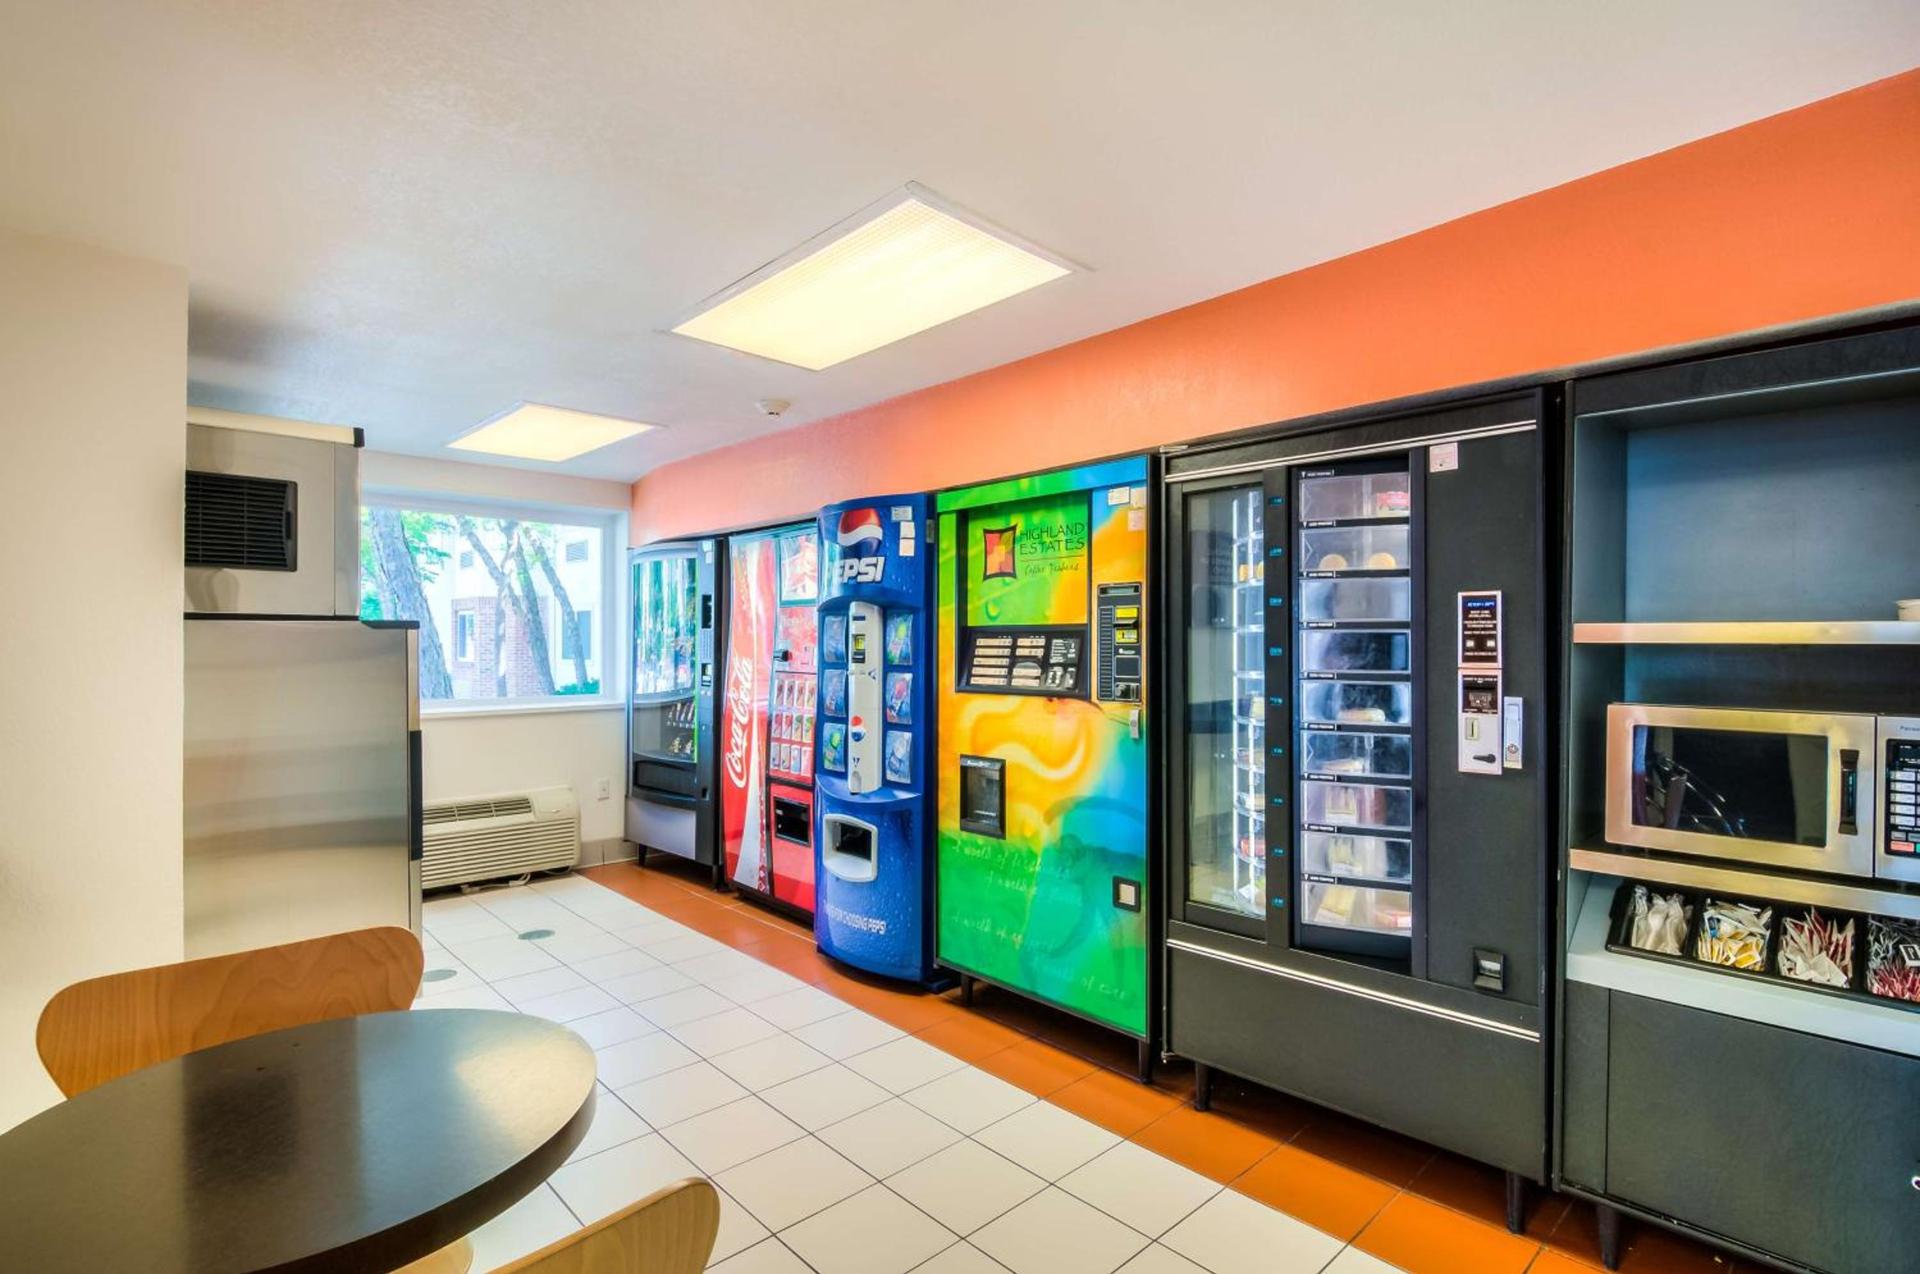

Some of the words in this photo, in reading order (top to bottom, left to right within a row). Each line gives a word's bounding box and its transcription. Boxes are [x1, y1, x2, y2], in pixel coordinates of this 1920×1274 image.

[1020, 523, 1085, 541] HIGHLAND
[1020, 538, 1085, 555] ESTATES
[832, 556, 886, 584] EPSI
